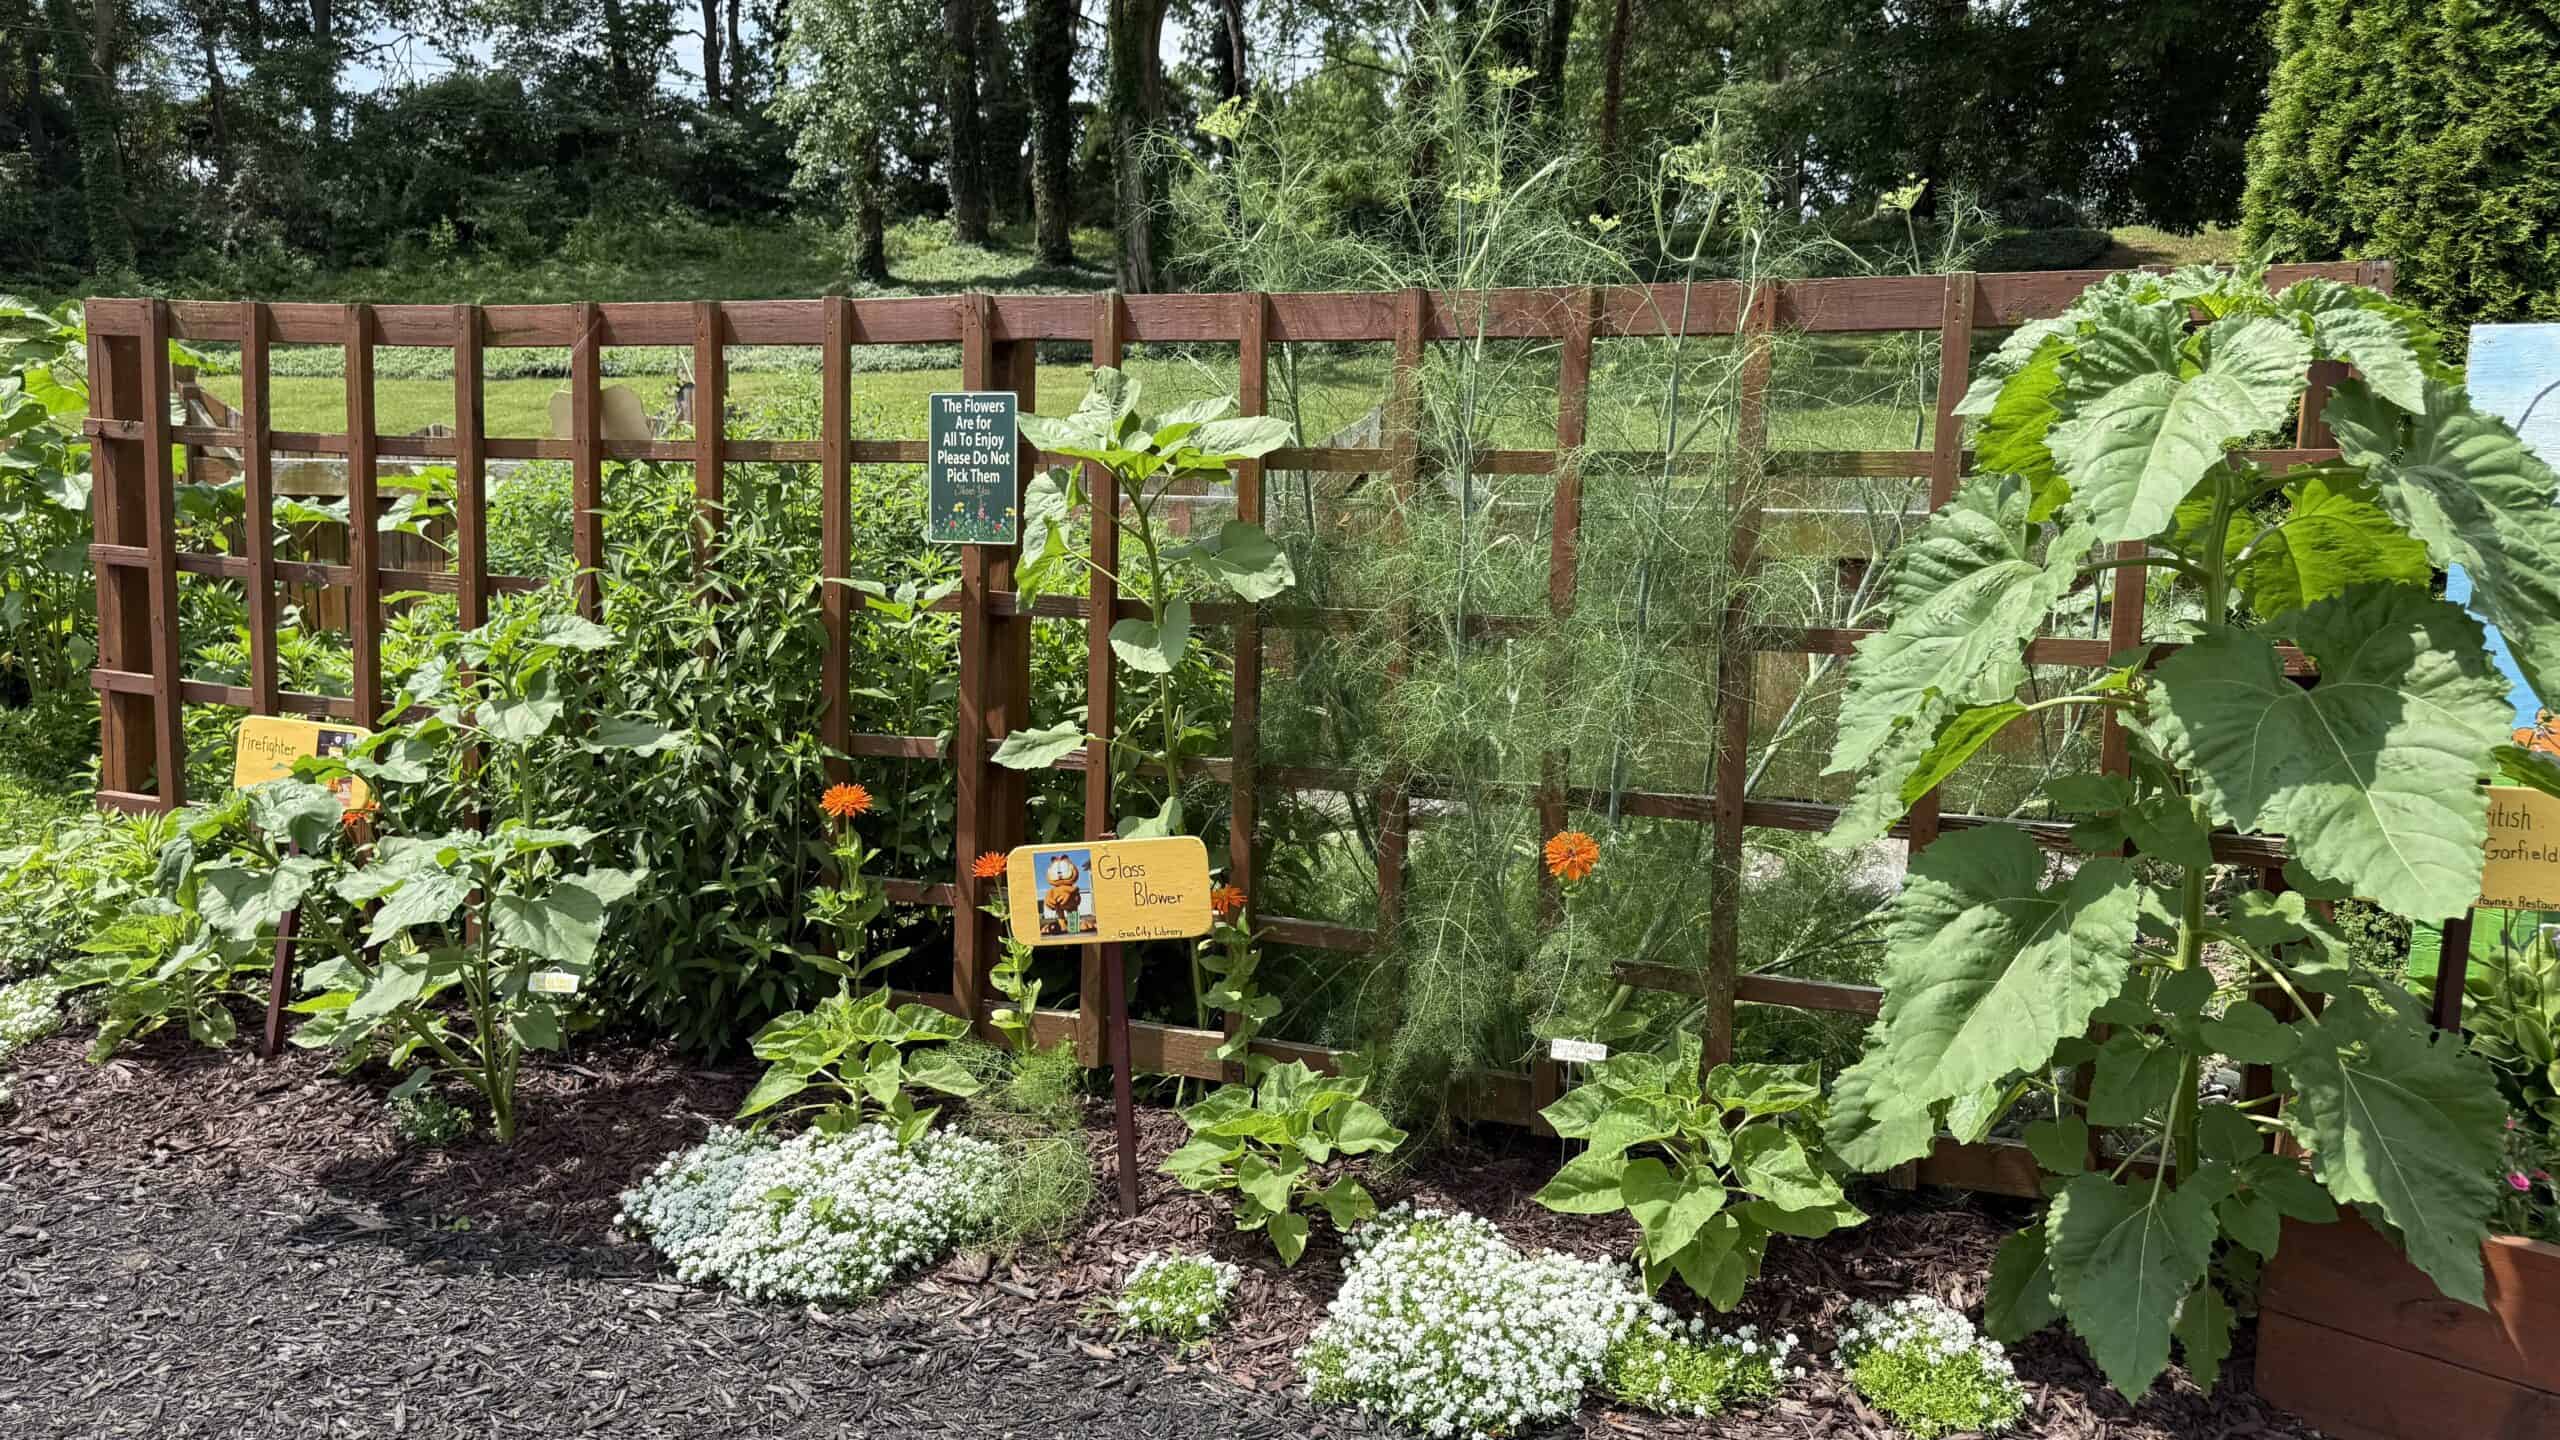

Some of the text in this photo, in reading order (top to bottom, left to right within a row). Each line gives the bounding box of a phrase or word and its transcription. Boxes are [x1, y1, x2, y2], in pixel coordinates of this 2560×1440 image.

[942, 398, 1006, 413] The Flowers
[955, 415, 992, 430] Are for
[943, 432, 1004, 450] All To Enjoy
[937, 450, 1010, 465] Please Do Not
[947, 468, 1000, 483] Pick Them
[242, 729, 296, 759] Firefighter
[2481, 837, 2558, 863] Garfield
[1098, 855, 1145, 880] Glass
[1133, 880, 1184, 906] Blower
[2519, 895, 2560, 910] Restaur
[1136, 926, 1152, 938] City
[1155, 925, 1183, 937] Library
